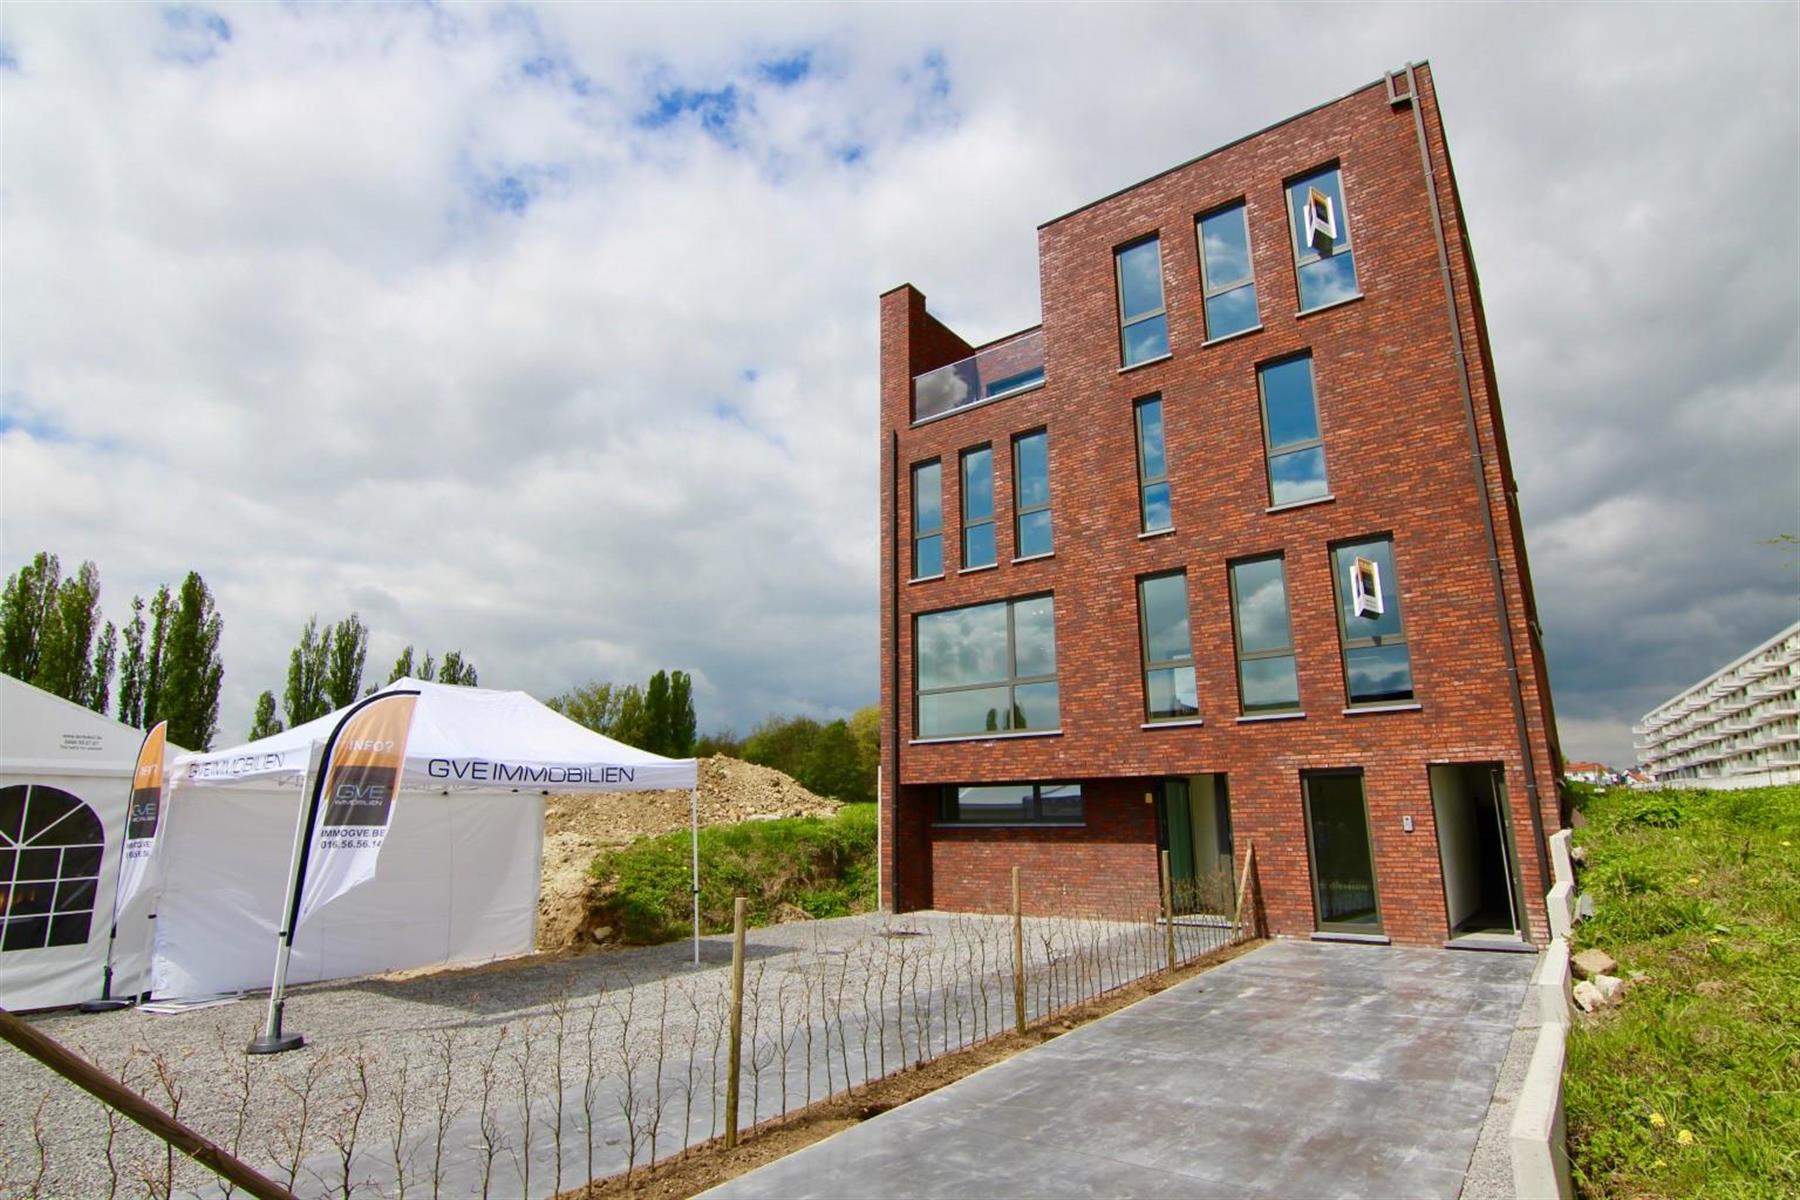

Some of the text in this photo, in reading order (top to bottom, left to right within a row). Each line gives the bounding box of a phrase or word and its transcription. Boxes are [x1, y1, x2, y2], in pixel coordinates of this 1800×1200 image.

[348, 740, 394, 753] INFO?
[336, 784, 385, 799] GVE
[320, 829, 385, 838] IMMOGVE.BE
